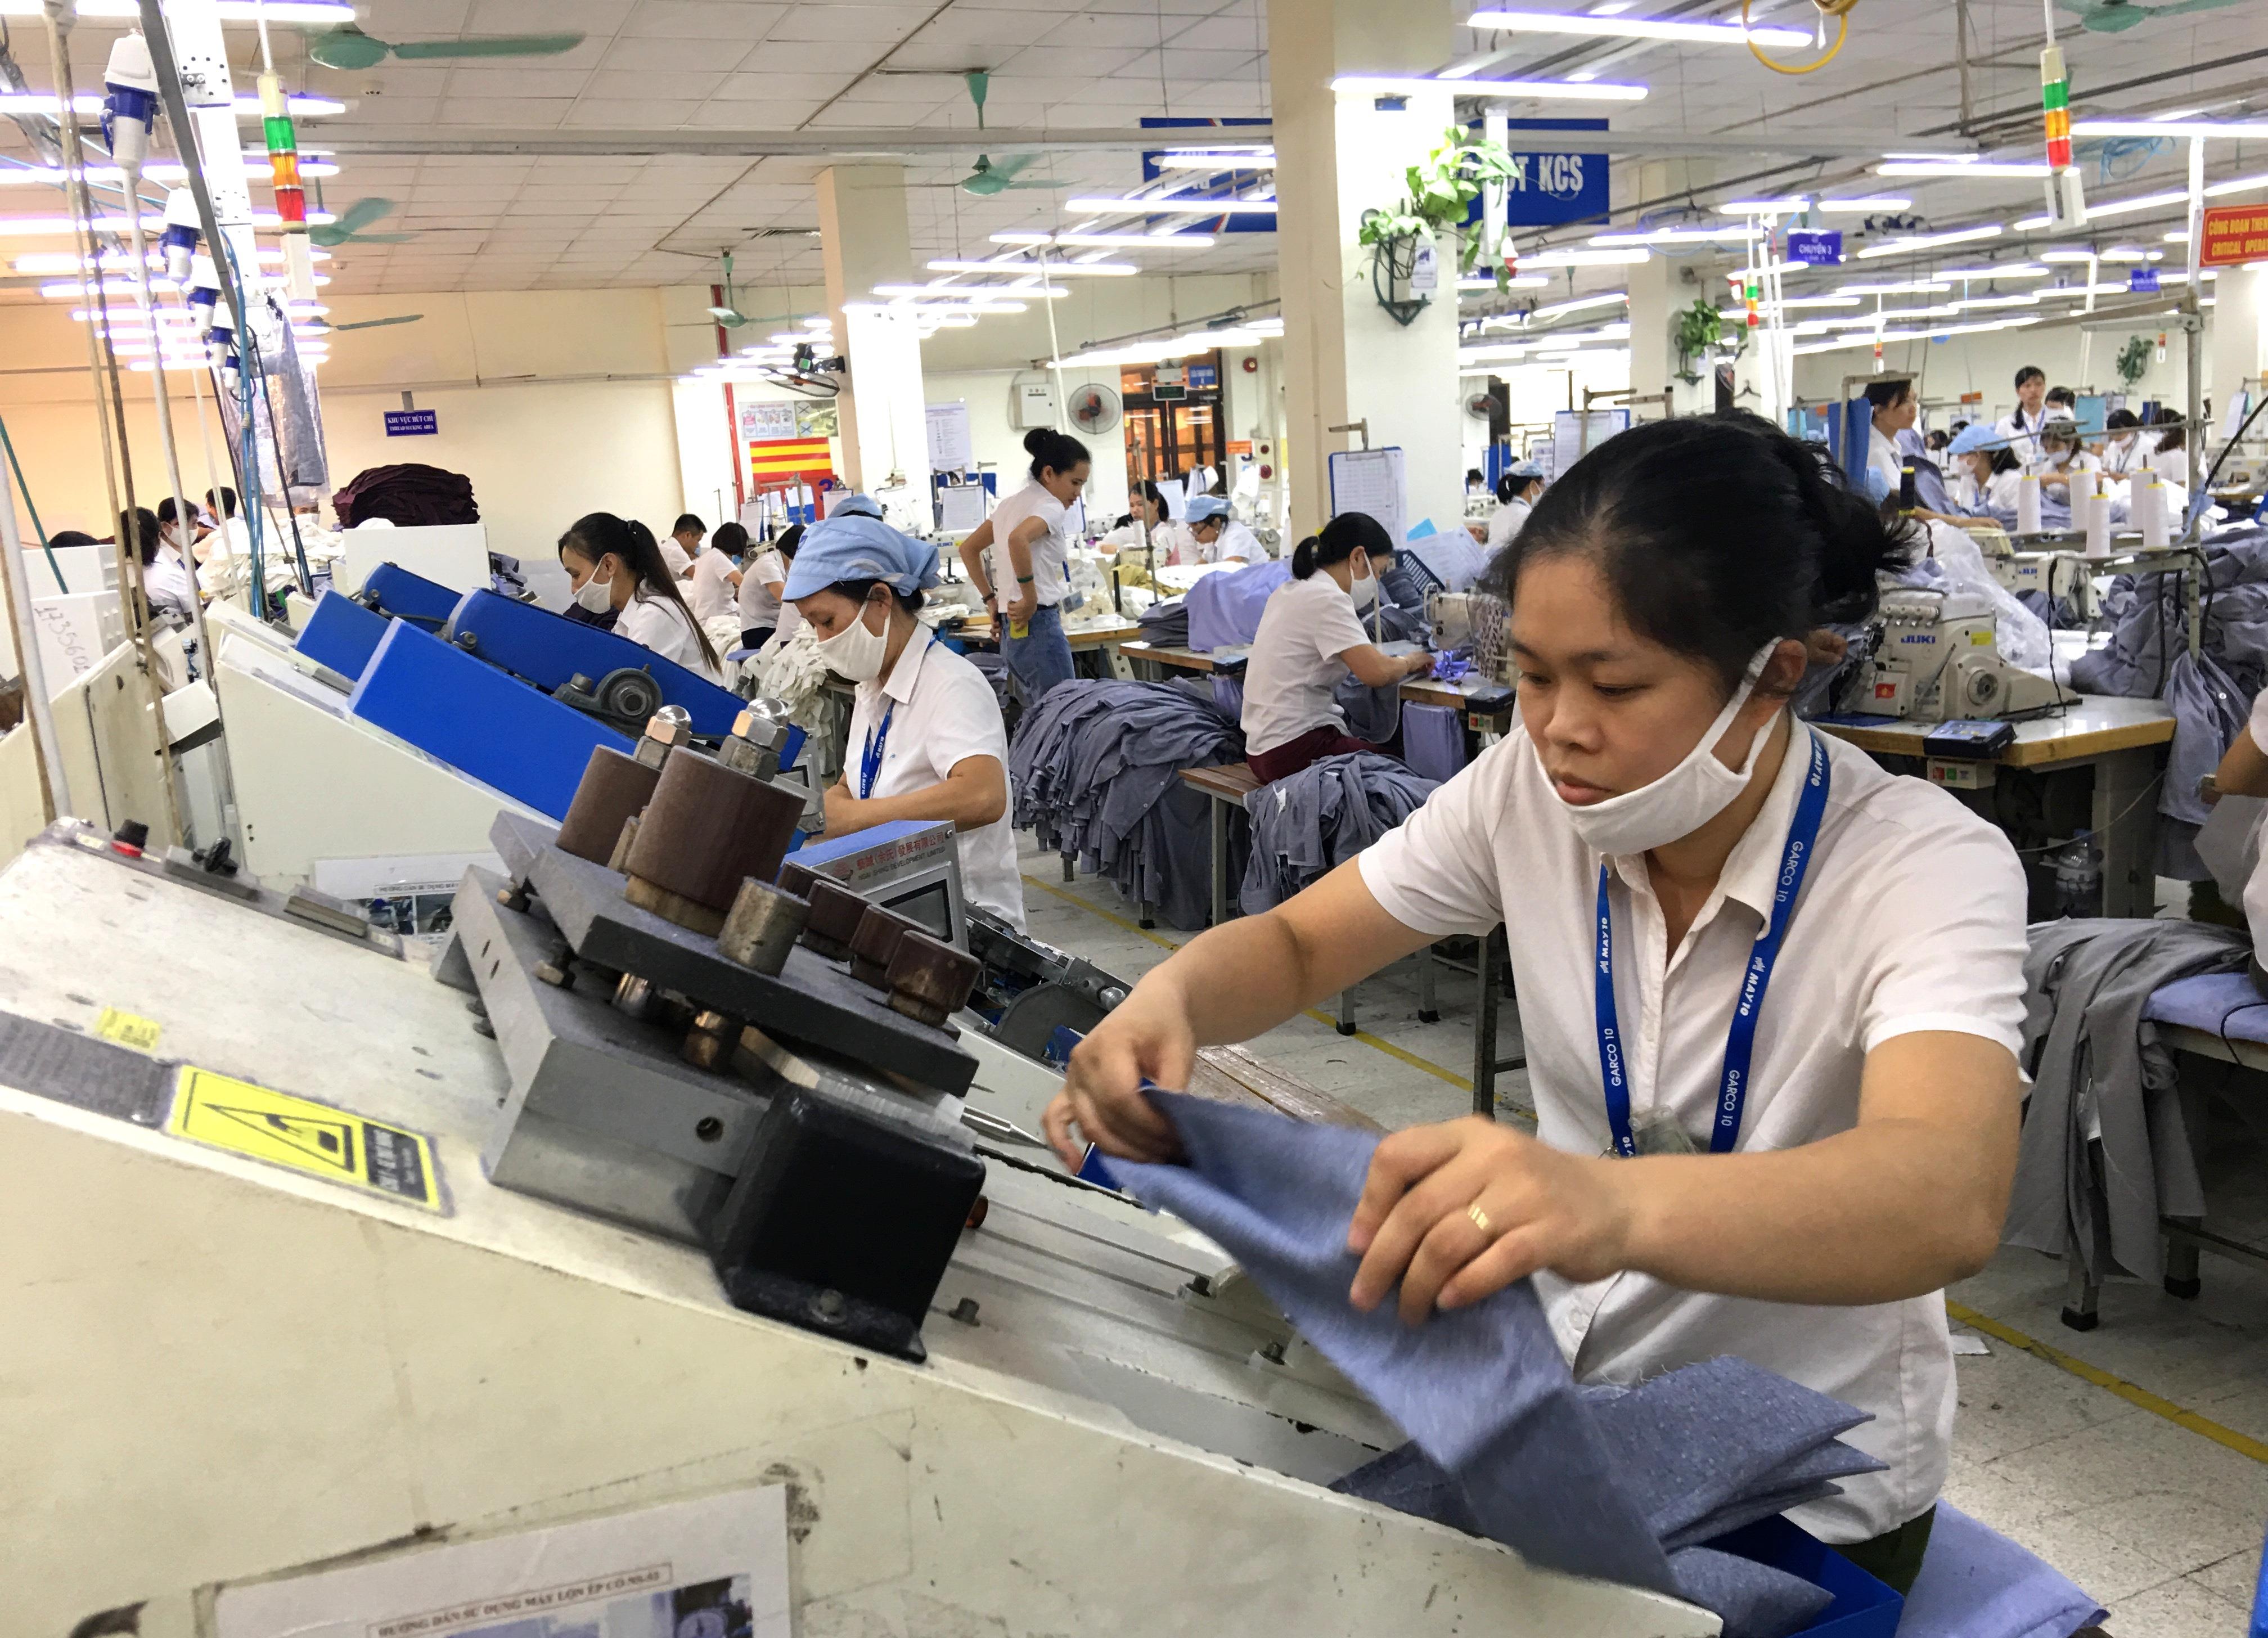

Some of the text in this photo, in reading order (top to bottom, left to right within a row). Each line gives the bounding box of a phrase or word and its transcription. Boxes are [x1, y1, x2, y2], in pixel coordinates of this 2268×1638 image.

[1538, 155, 1583, 192] KCS
[2211, 241, 2242, 256] CRITICAL
[1900, 634, 1936, 644] JUKI
[890, 852, 925, 870] DEVELOPMENT
[926, 846, 946, 858] LIMITED
[1776, 840, 1804, 902] GARCO 10
[1601, 931, 1610, 958] MAY
[1744, 972, 1759, 1003] MAY
[1604, 1028, 1622, 1086] GARCO 10
[1721, 1069, 1740, 1126] GARCO 10
